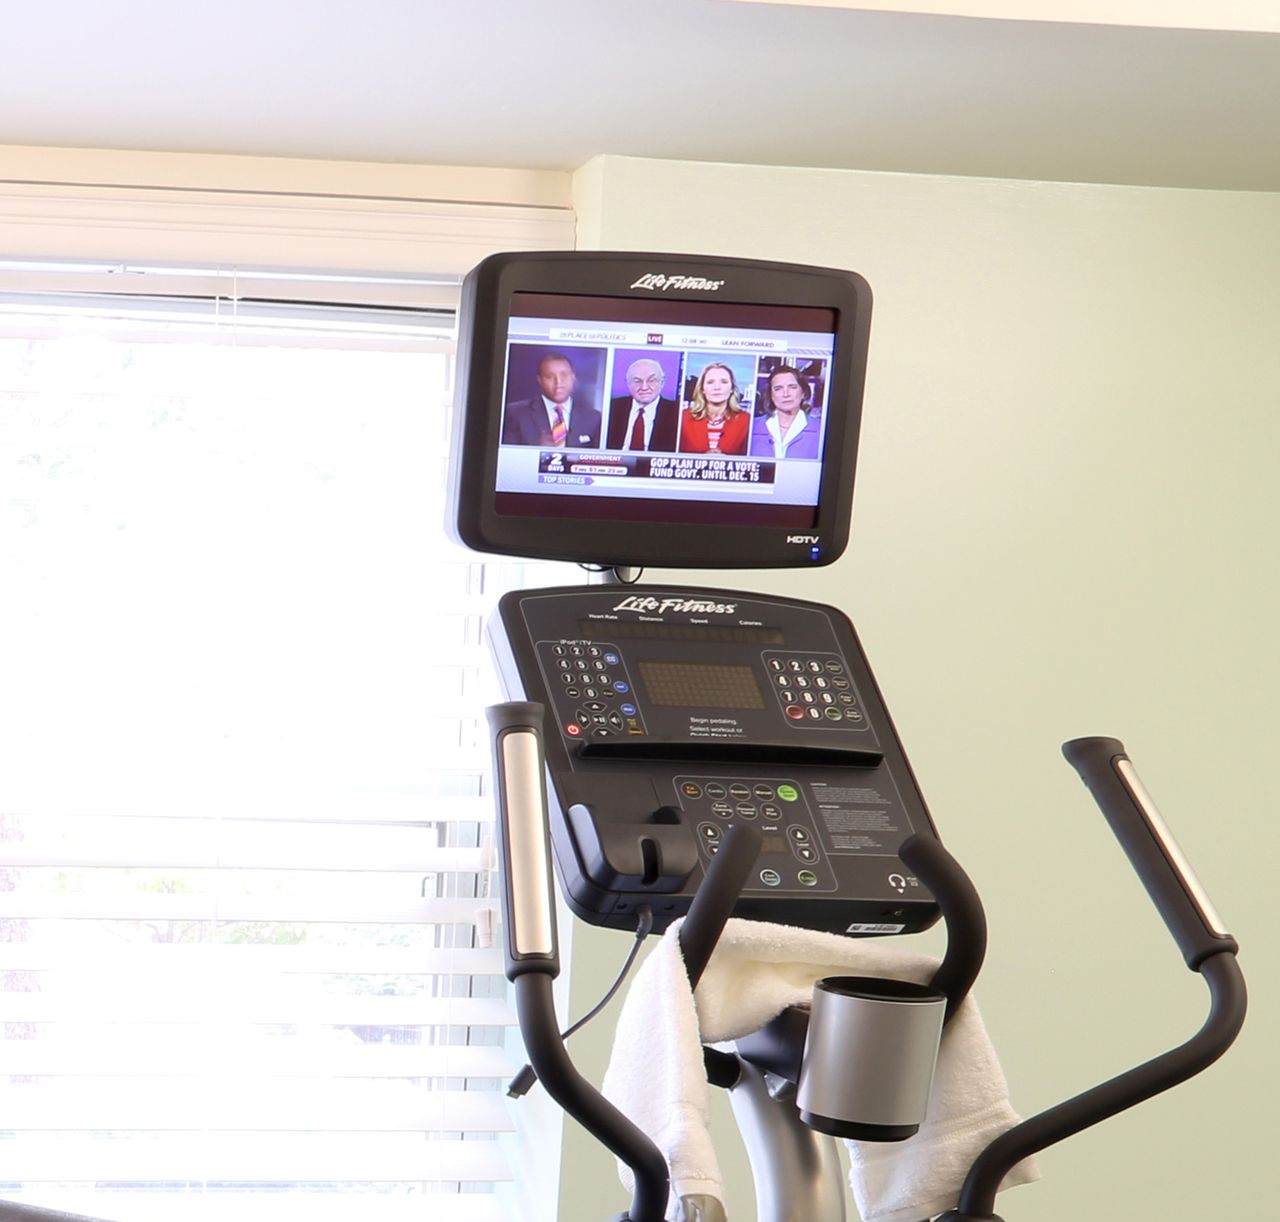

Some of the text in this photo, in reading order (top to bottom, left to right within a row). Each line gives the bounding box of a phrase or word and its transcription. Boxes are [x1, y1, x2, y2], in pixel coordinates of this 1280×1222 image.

[630, 274, 720, 291] Life Fitness
[648, 336, 662, 344] LIVE
[550, 453, 562, 464] 2
[650, 458, 760, 472] GOP PLAN UP FOR A VOTE:
[649, 468, 759, 481] FUND GOVT. UNTIL DEC. 15
[613, 596, 735, 614] Life Fitness
